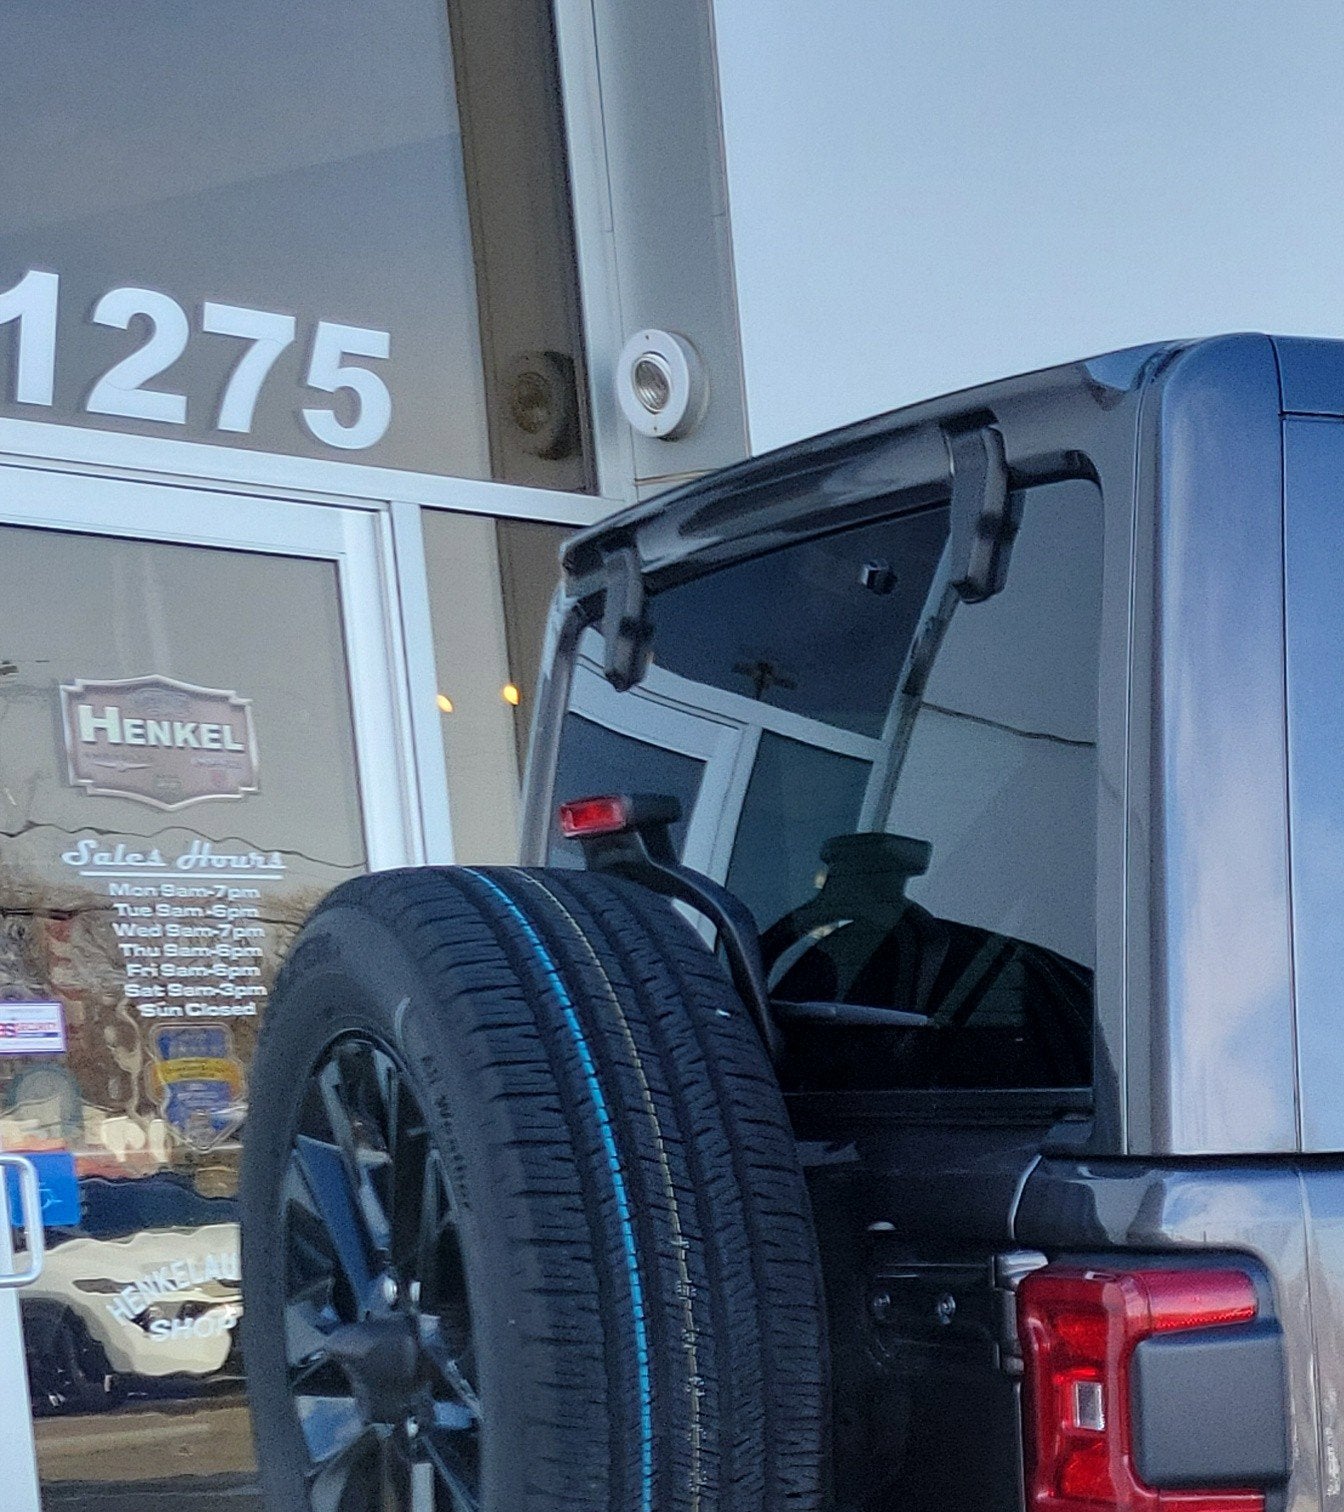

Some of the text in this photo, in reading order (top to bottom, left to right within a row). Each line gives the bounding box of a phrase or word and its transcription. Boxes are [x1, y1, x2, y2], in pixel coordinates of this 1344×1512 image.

[0, 270, 392, 450] 1275
[77, 704, 245, 752] HENKEL
[61, 839, 287, 870] Sales Hours
[109, 882, 158, 897] Mon
[113, 903, 152, 917] Tue
[112, 923, 162, 937] Wed
[118, 943, 161, 957] Thu
[126, 963, 159, 978] Fri
[124, 983, 166, 997] Sat
[139, 1002, 257, 1017] Sun Closed
[148, 1314, 238, 1343] SHOP
